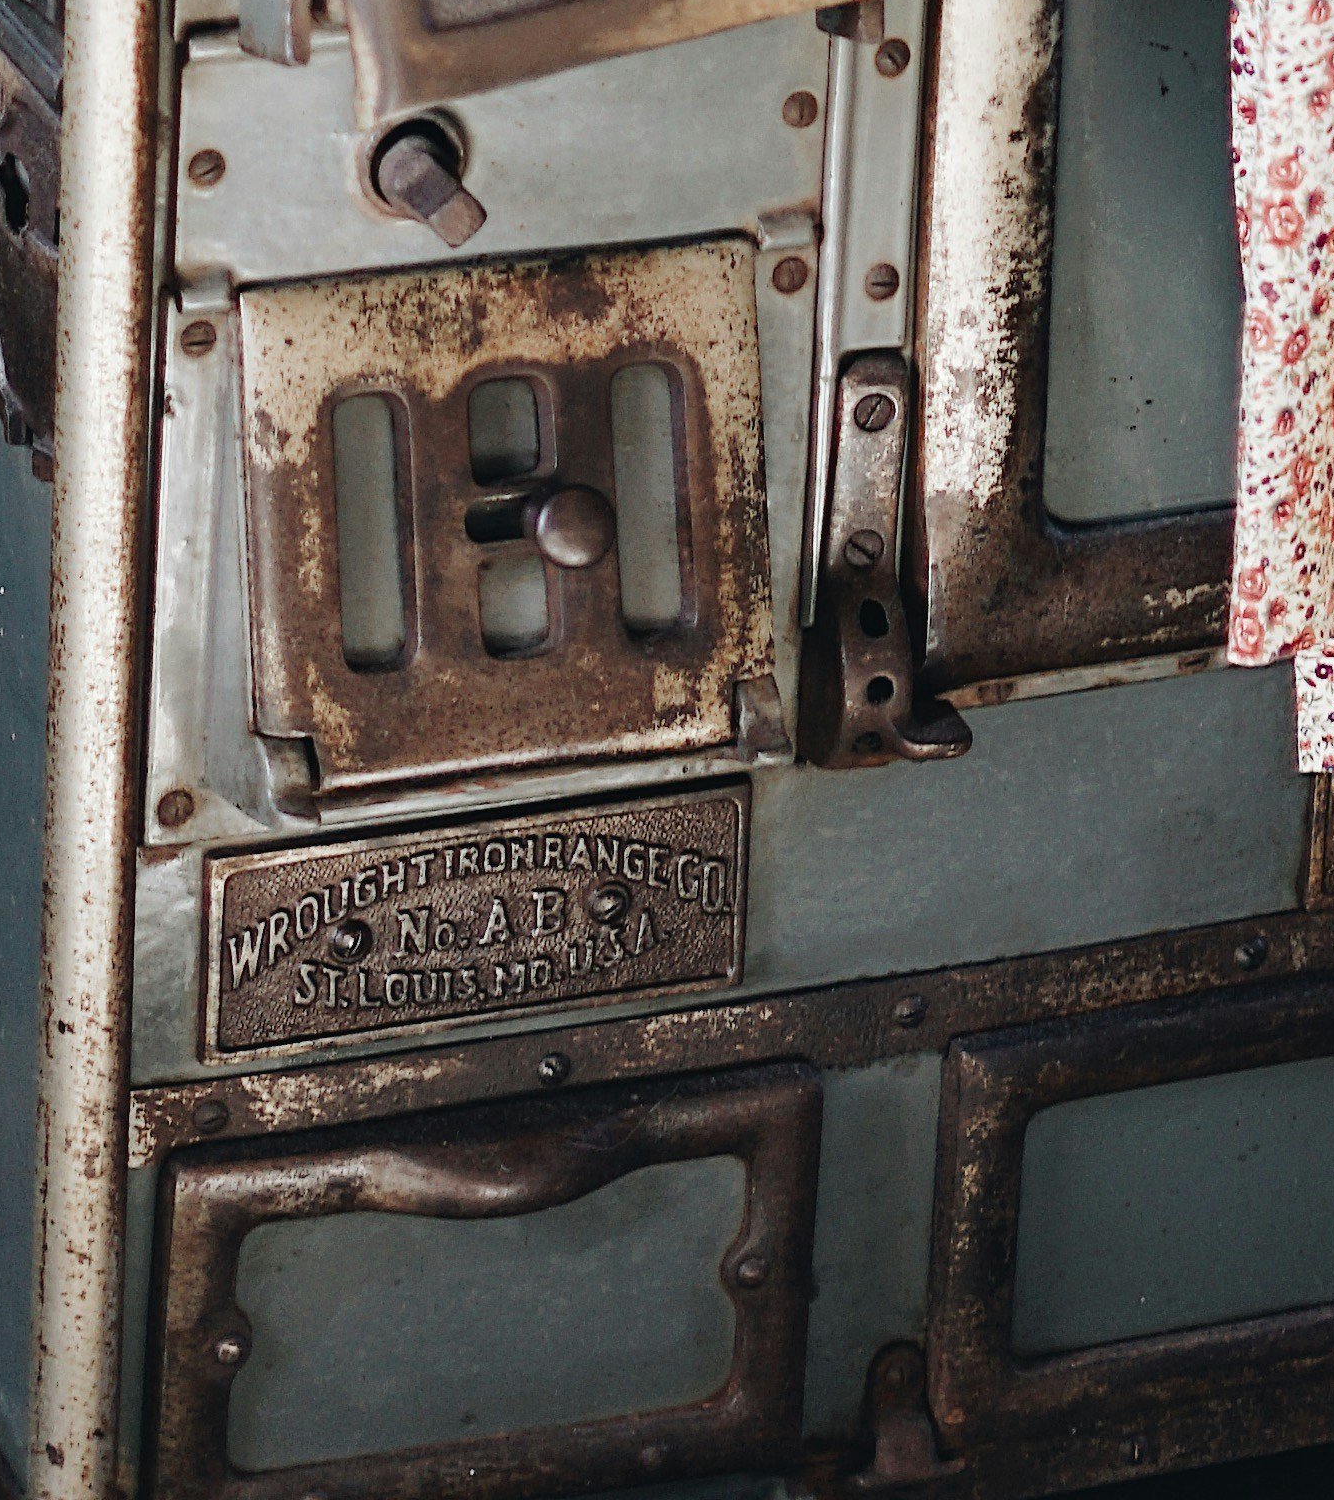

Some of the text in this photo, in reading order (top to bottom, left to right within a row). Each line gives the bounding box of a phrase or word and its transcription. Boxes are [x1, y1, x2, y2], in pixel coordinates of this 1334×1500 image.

[227, 836, 731, 990] WROUGHT IRON RANGE CO.
[478, 899, 510, 946] A
[531, 889, 566, 937] B
